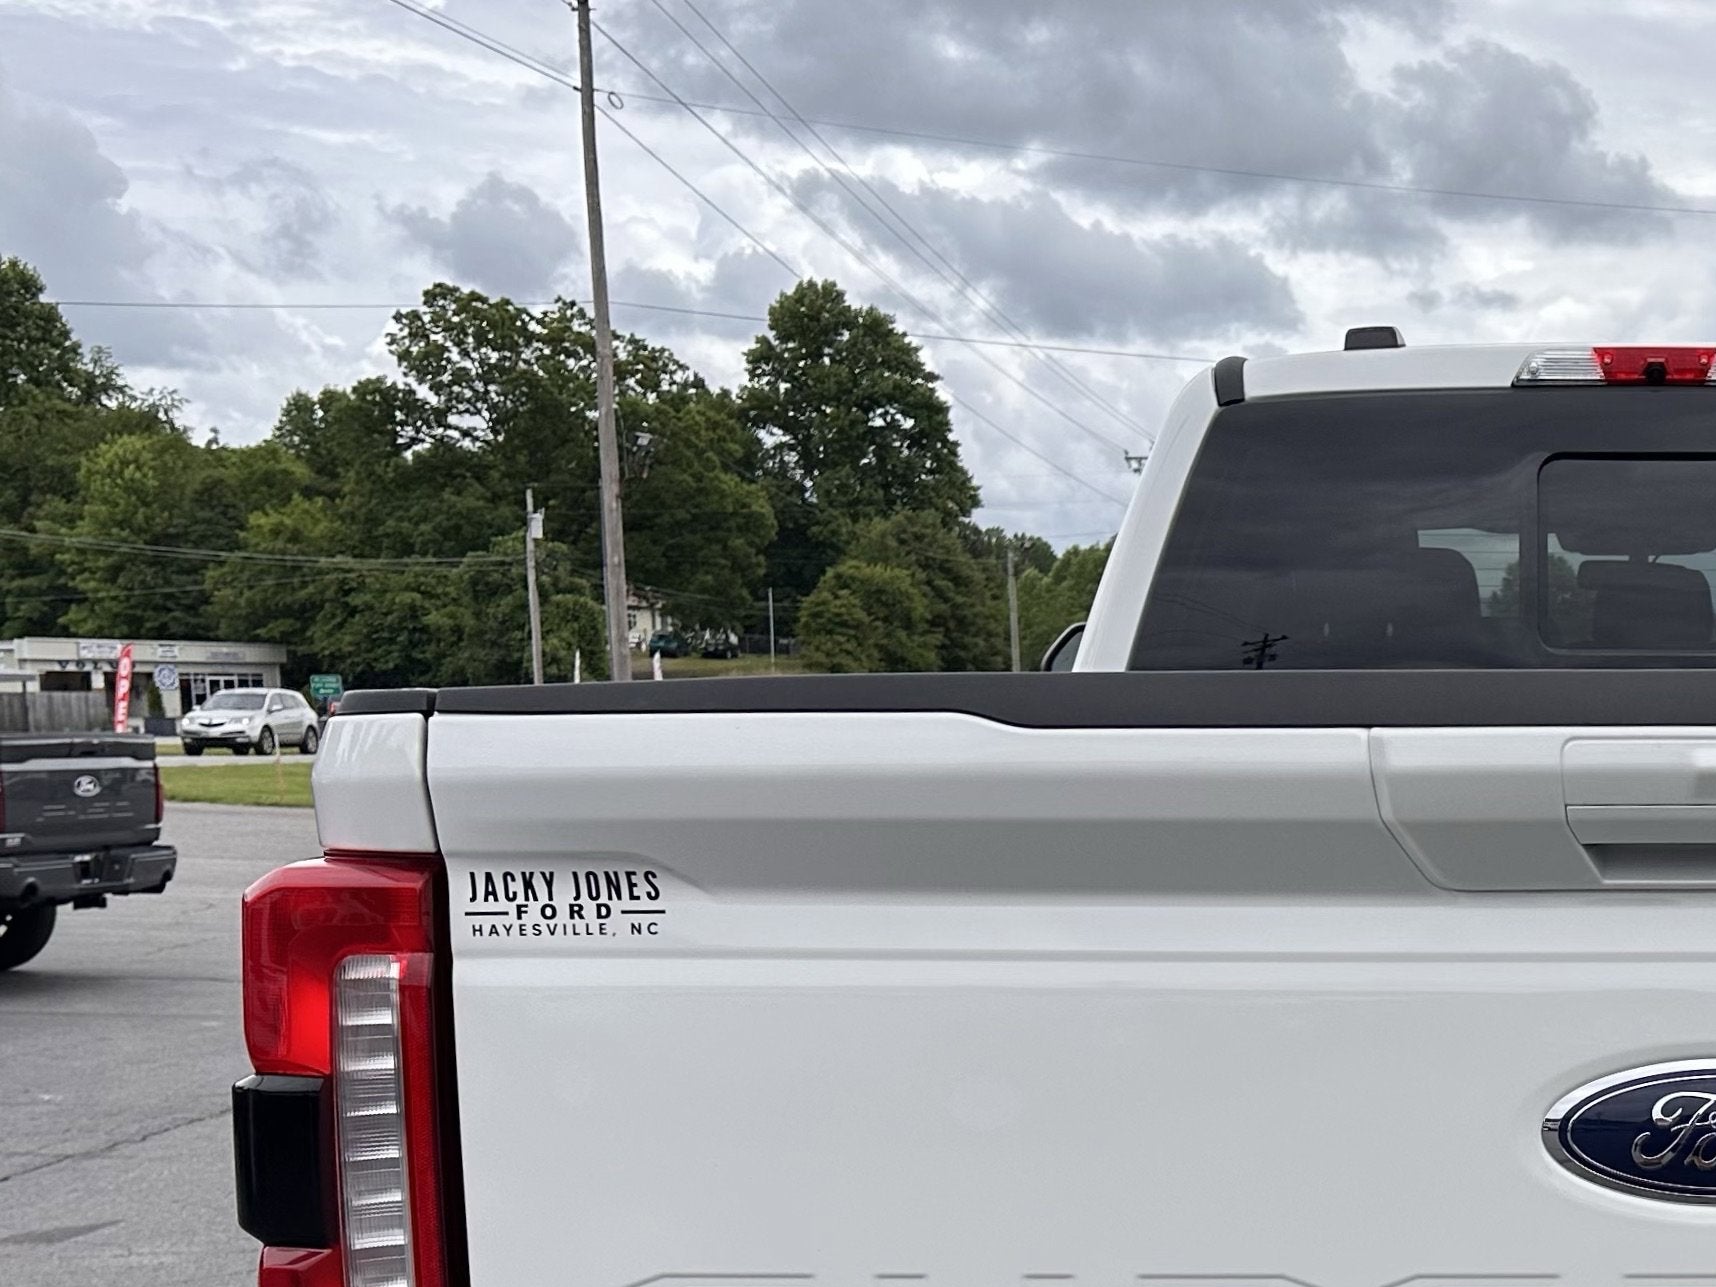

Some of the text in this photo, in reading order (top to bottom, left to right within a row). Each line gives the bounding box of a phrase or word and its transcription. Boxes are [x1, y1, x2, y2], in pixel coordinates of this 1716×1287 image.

[469, 870, 661, 903] JACKY JONES
[516, 903, 612, 921] FORD
[472, 922, 659, 937] HAYESVILLE, NC
